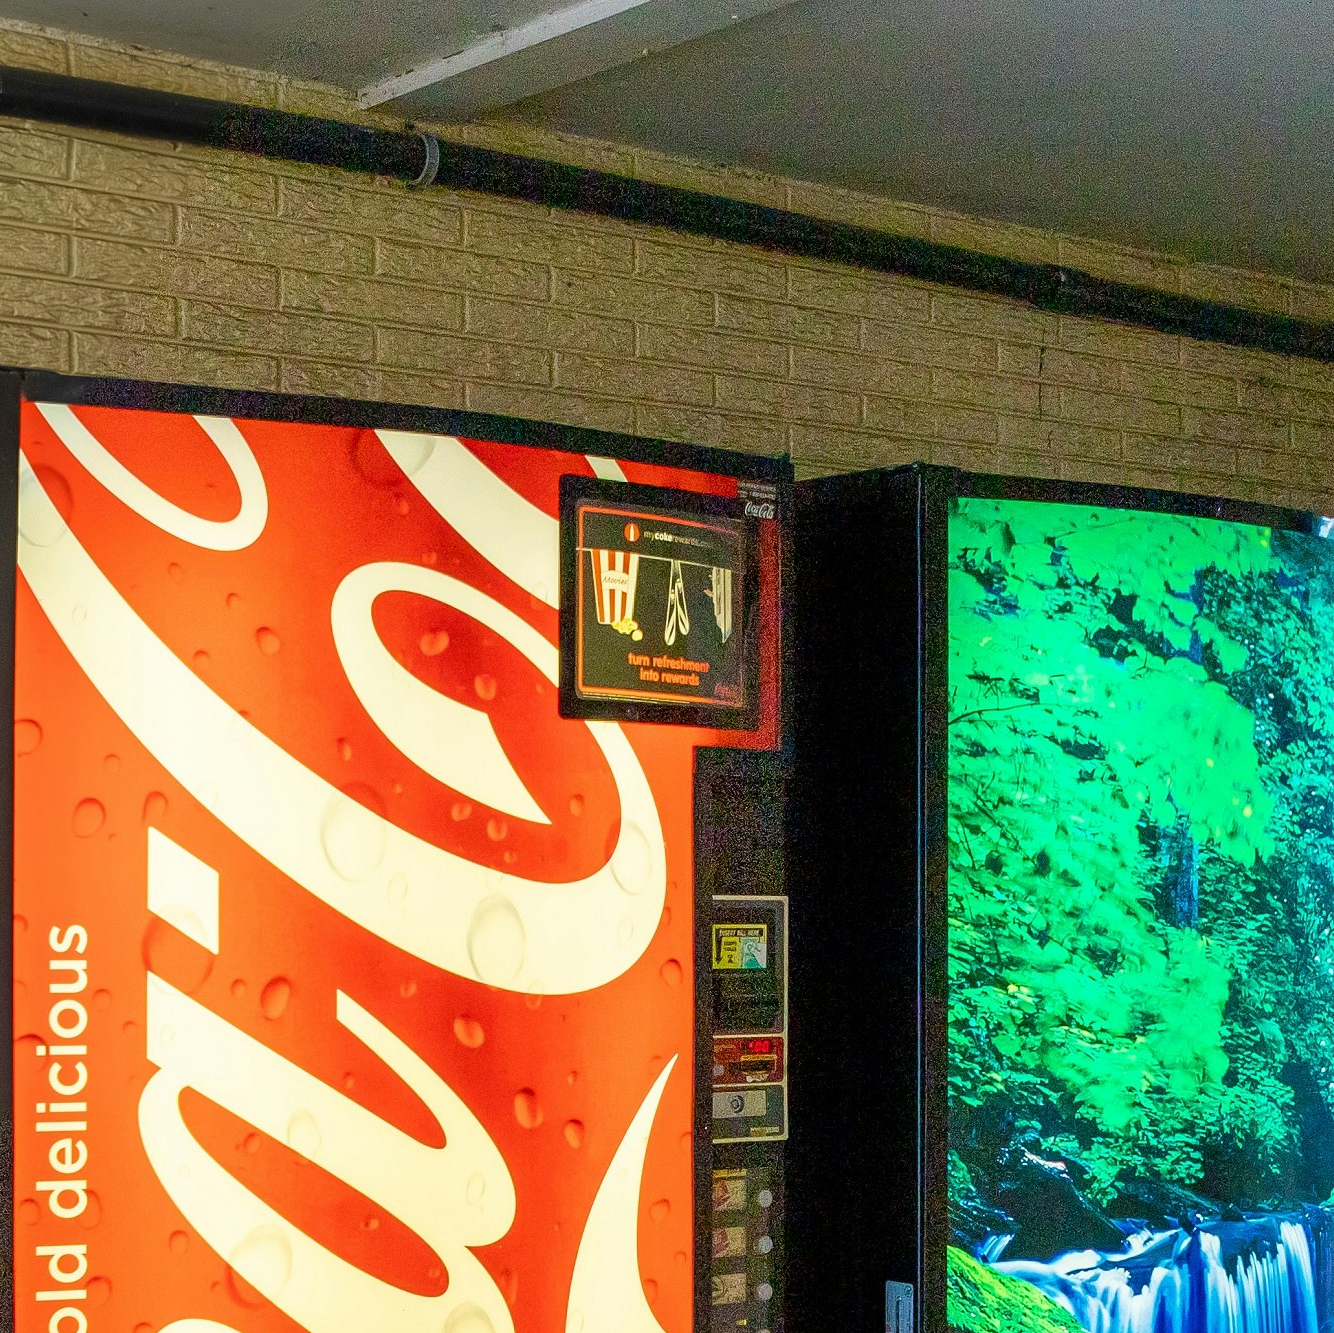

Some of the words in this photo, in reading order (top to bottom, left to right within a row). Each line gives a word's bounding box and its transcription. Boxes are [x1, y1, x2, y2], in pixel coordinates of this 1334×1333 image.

[627, 653, 650, 667] turn
[652, 655, 710, 674] refreshment
[639, 667, 659, 681] into
[660, 671, 701, 687] rewards
[35, 924, 87, 1218] delicious
